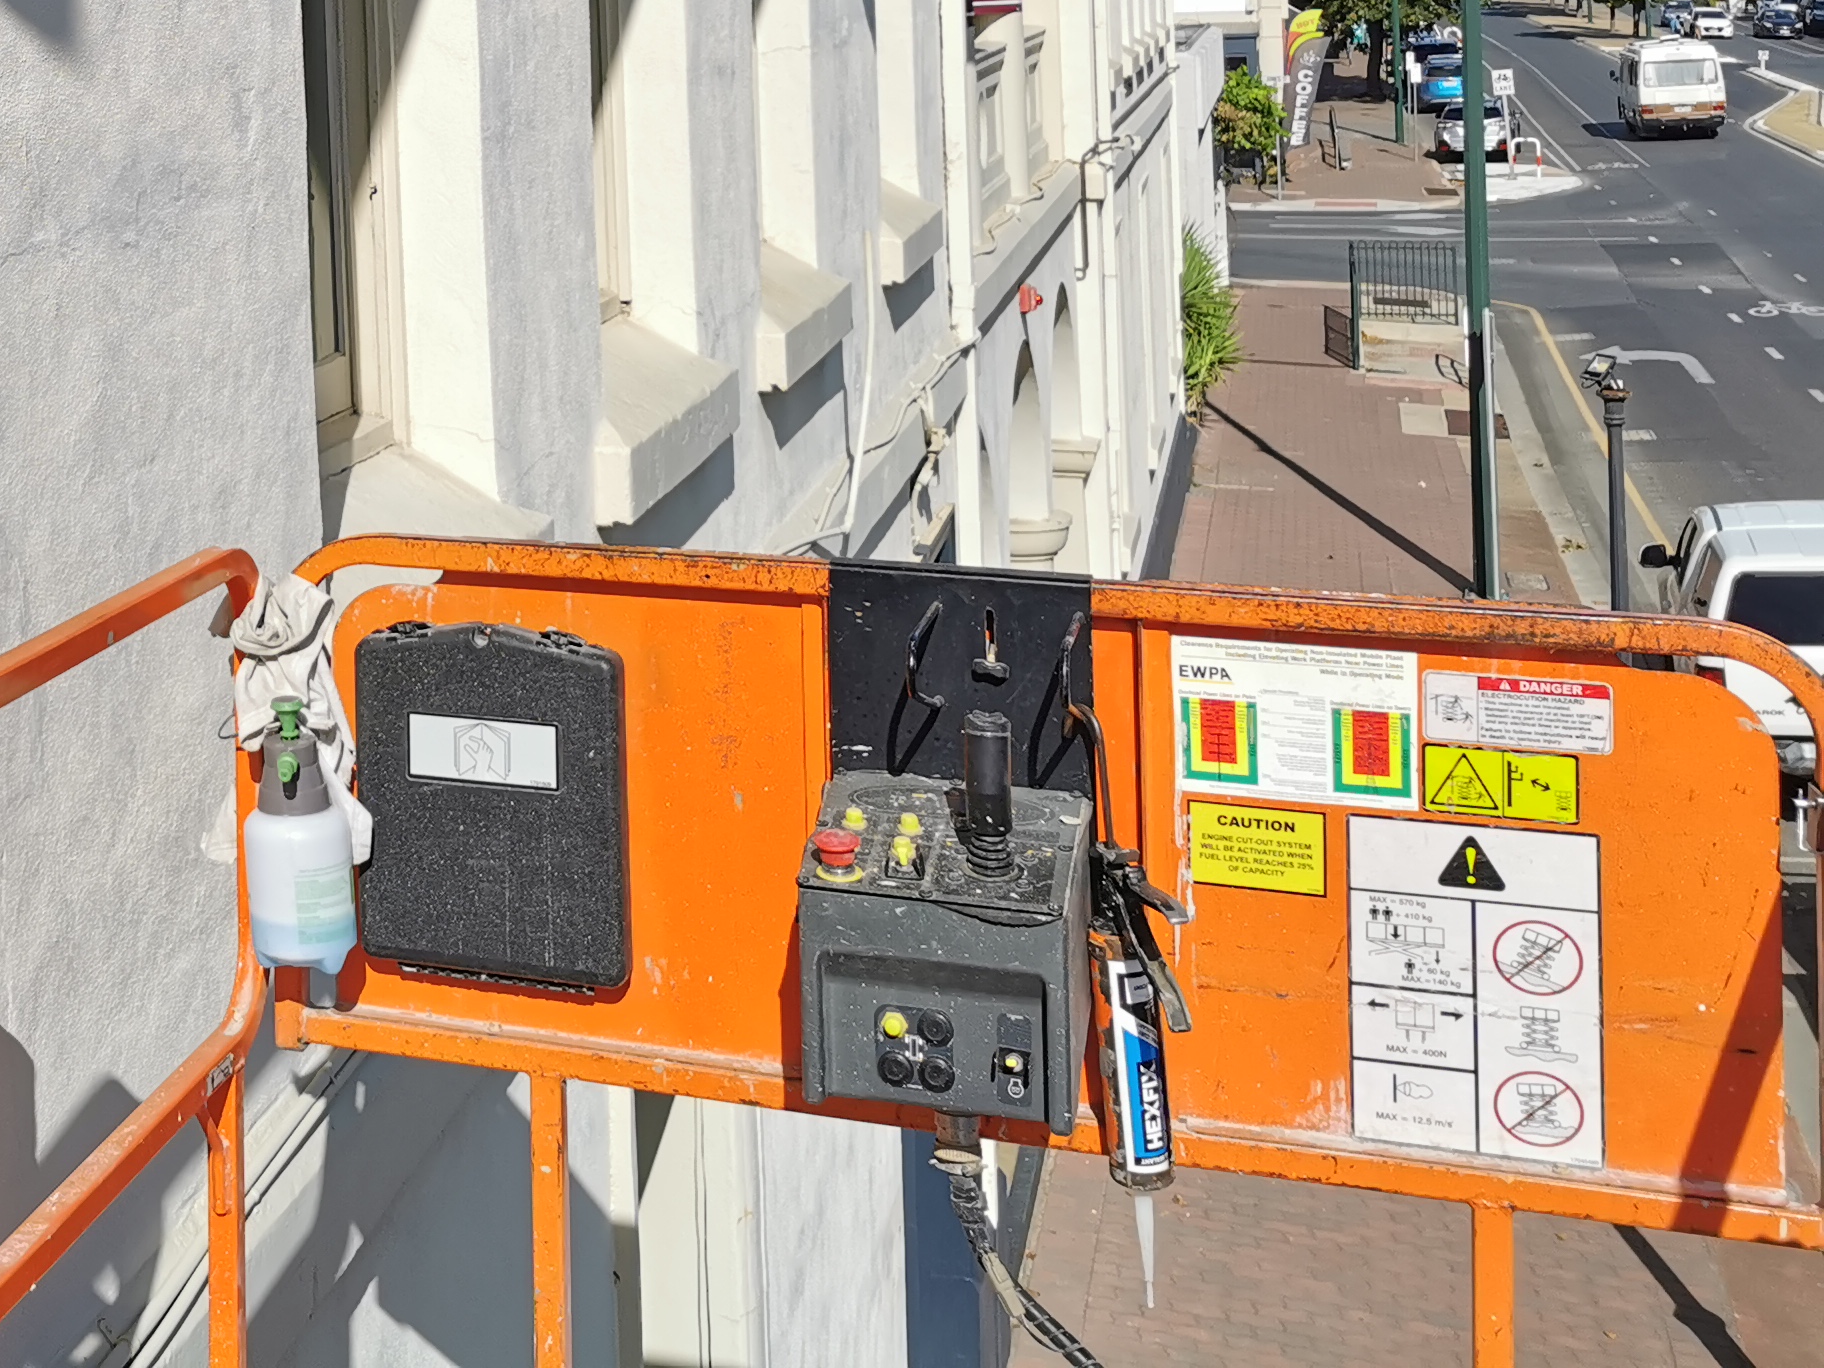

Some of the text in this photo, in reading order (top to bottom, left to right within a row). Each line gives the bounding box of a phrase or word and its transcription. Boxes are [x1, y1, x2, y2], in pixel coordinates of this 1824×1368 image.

[1290, 69, 1314, 146] COFFEE
[1179, 664, 1232, 681] EWPA
[1519, 681, 1583, 695] DANGER
[1481, 692, 1585, 705] ELECTROCUTION HAZARD
[1217, 815, 1295, 832] CAUTION
[1201, 833, 1312, 850] ENGINE CUT-OUT SYSTEM
[1200, 842, 1313, 860] WILL BE ACTIVATED WHEN
[1199, 852, 1314, 871] FUEL LEVEL REACHES 25%
[1242, 866, 1286, 877] CAPACITY
[1369, 896, 1387, 904] MAX
[1399, 898, 1414, 906] 570
[1416, 900, 1426, 909] kg
[1422, 914, 1433, 923] kg
[1440, 968, 1450, 977] kg
[1433, 978, 1448, 986] 140
[1450, 980, 1461, 989] kg
[1386, 1044, 1408, 1054] MAX
[1140, 1060, 1164, 1151] HEXFIX
[1376, 1112, 1397, 1121] MAX
[1413, 1116, 1432, 1125] 12.5
[1435, 1119, 1453, 1128] m/s
